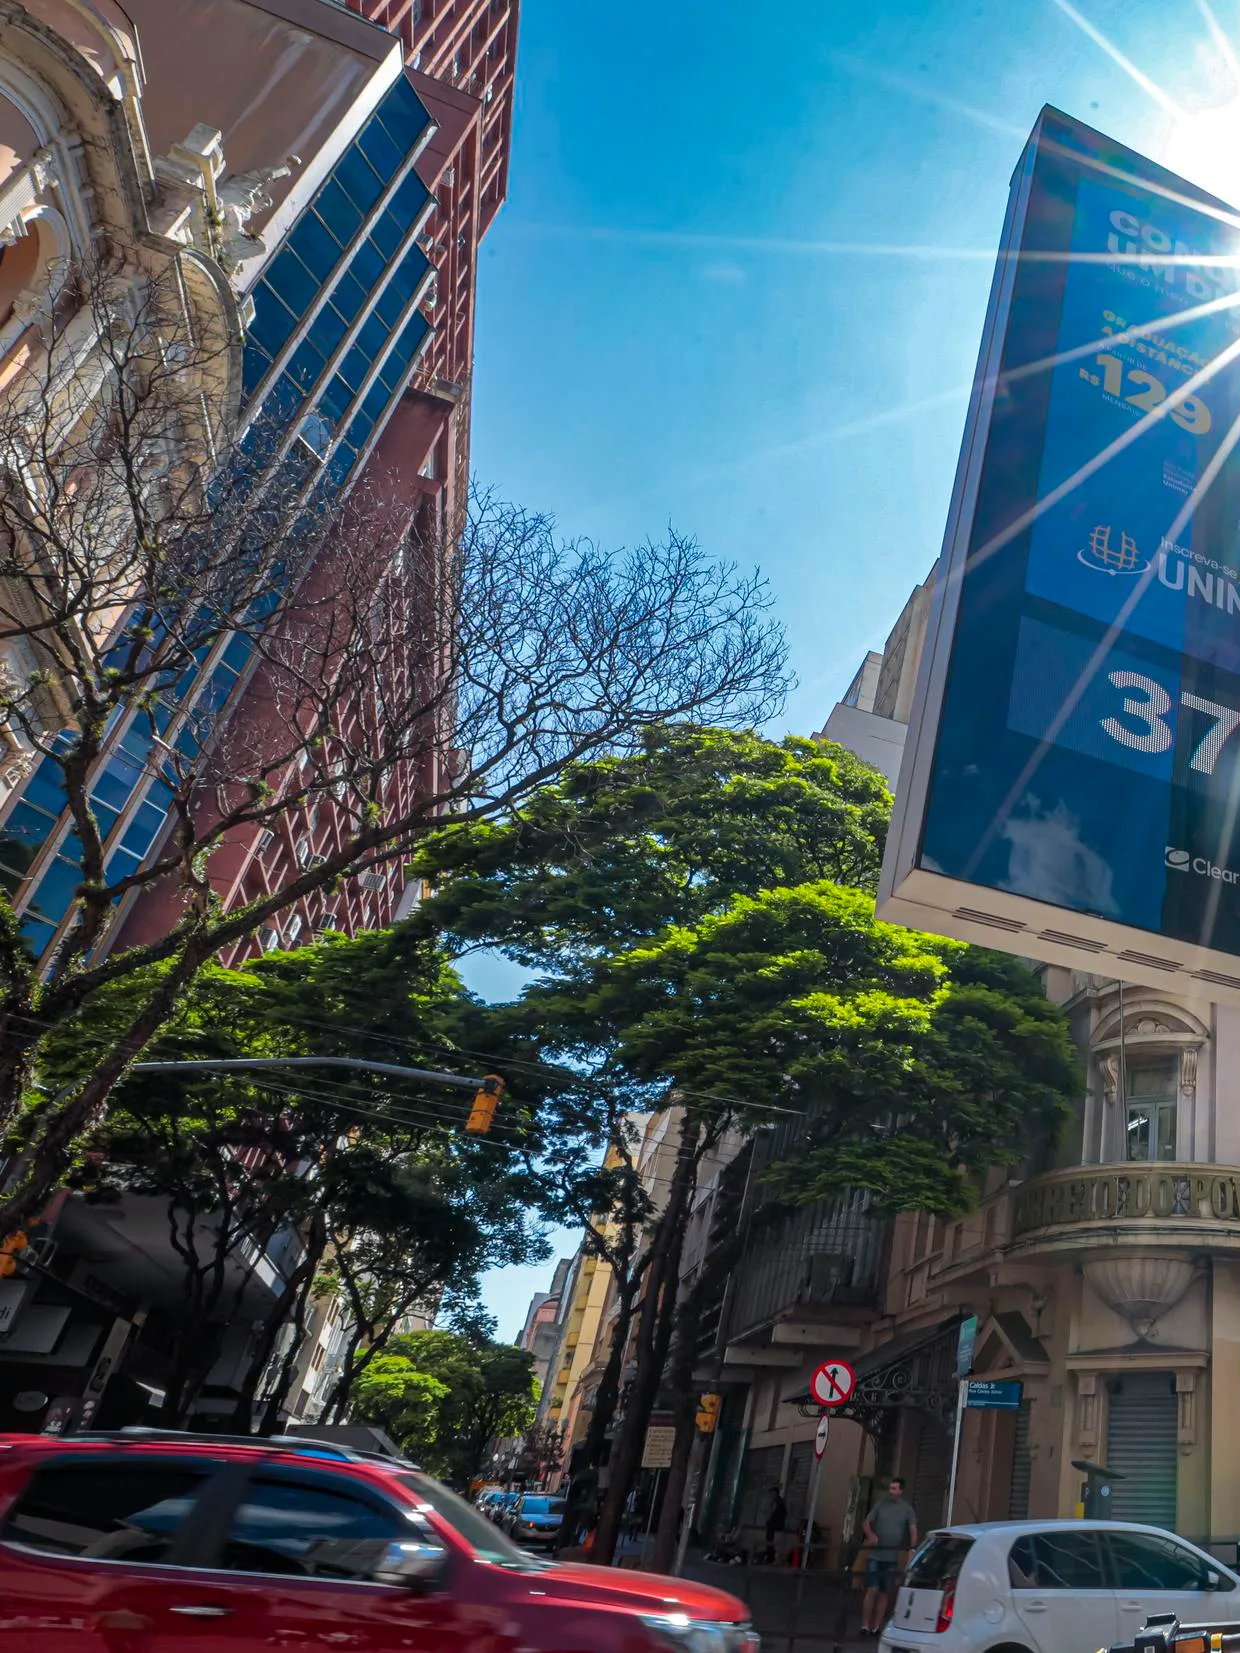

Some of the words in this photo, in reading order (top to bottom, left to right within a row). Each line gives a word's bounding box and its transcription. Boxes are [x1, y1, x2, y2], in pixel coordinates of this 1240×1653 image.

[1096, 354, 1212, 435] 129
[1161, 535, 1238, 580] Inscreva-se
[1193, 858, 1240, 885] Clear
[1125, 1174, 1175, 1218] DO
[969, 1382, 989, 1390] Caldas
